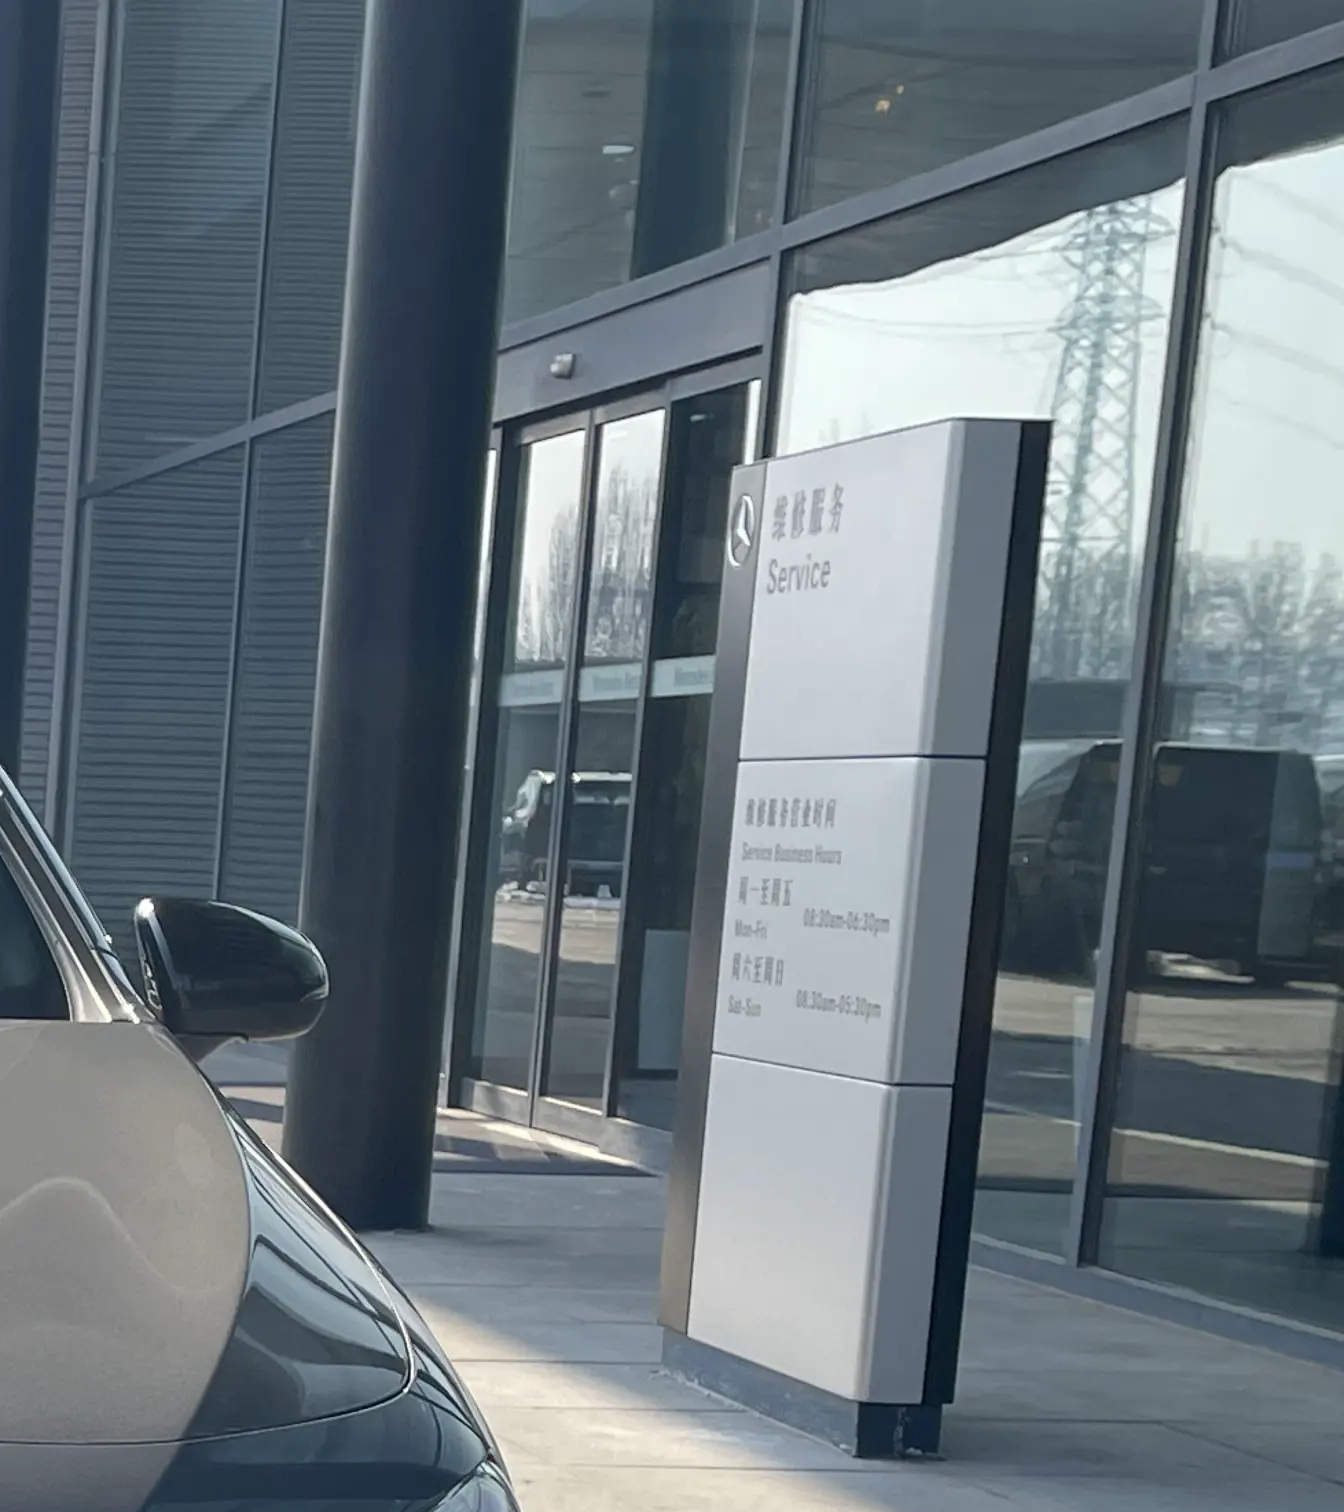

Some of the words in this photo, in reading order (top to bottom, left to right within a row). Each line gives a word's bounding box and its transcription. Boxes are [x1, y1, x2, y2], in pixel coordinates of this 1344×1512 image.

[771, 482, 844, 541] 维修服务
[766, 553, 831, 595] Service
[741, 842, 773, 862] Service
[774, 843, 813, 864] Business
[815, 845, 842, 865] Hours
[738, 876, 794, 906] 周一至周五
[734, 919, 768, 940] Mon-Fri
[731, 952, 785, 986] 周六至周日
[727, 994, 762, 1017] Sat-Sun
